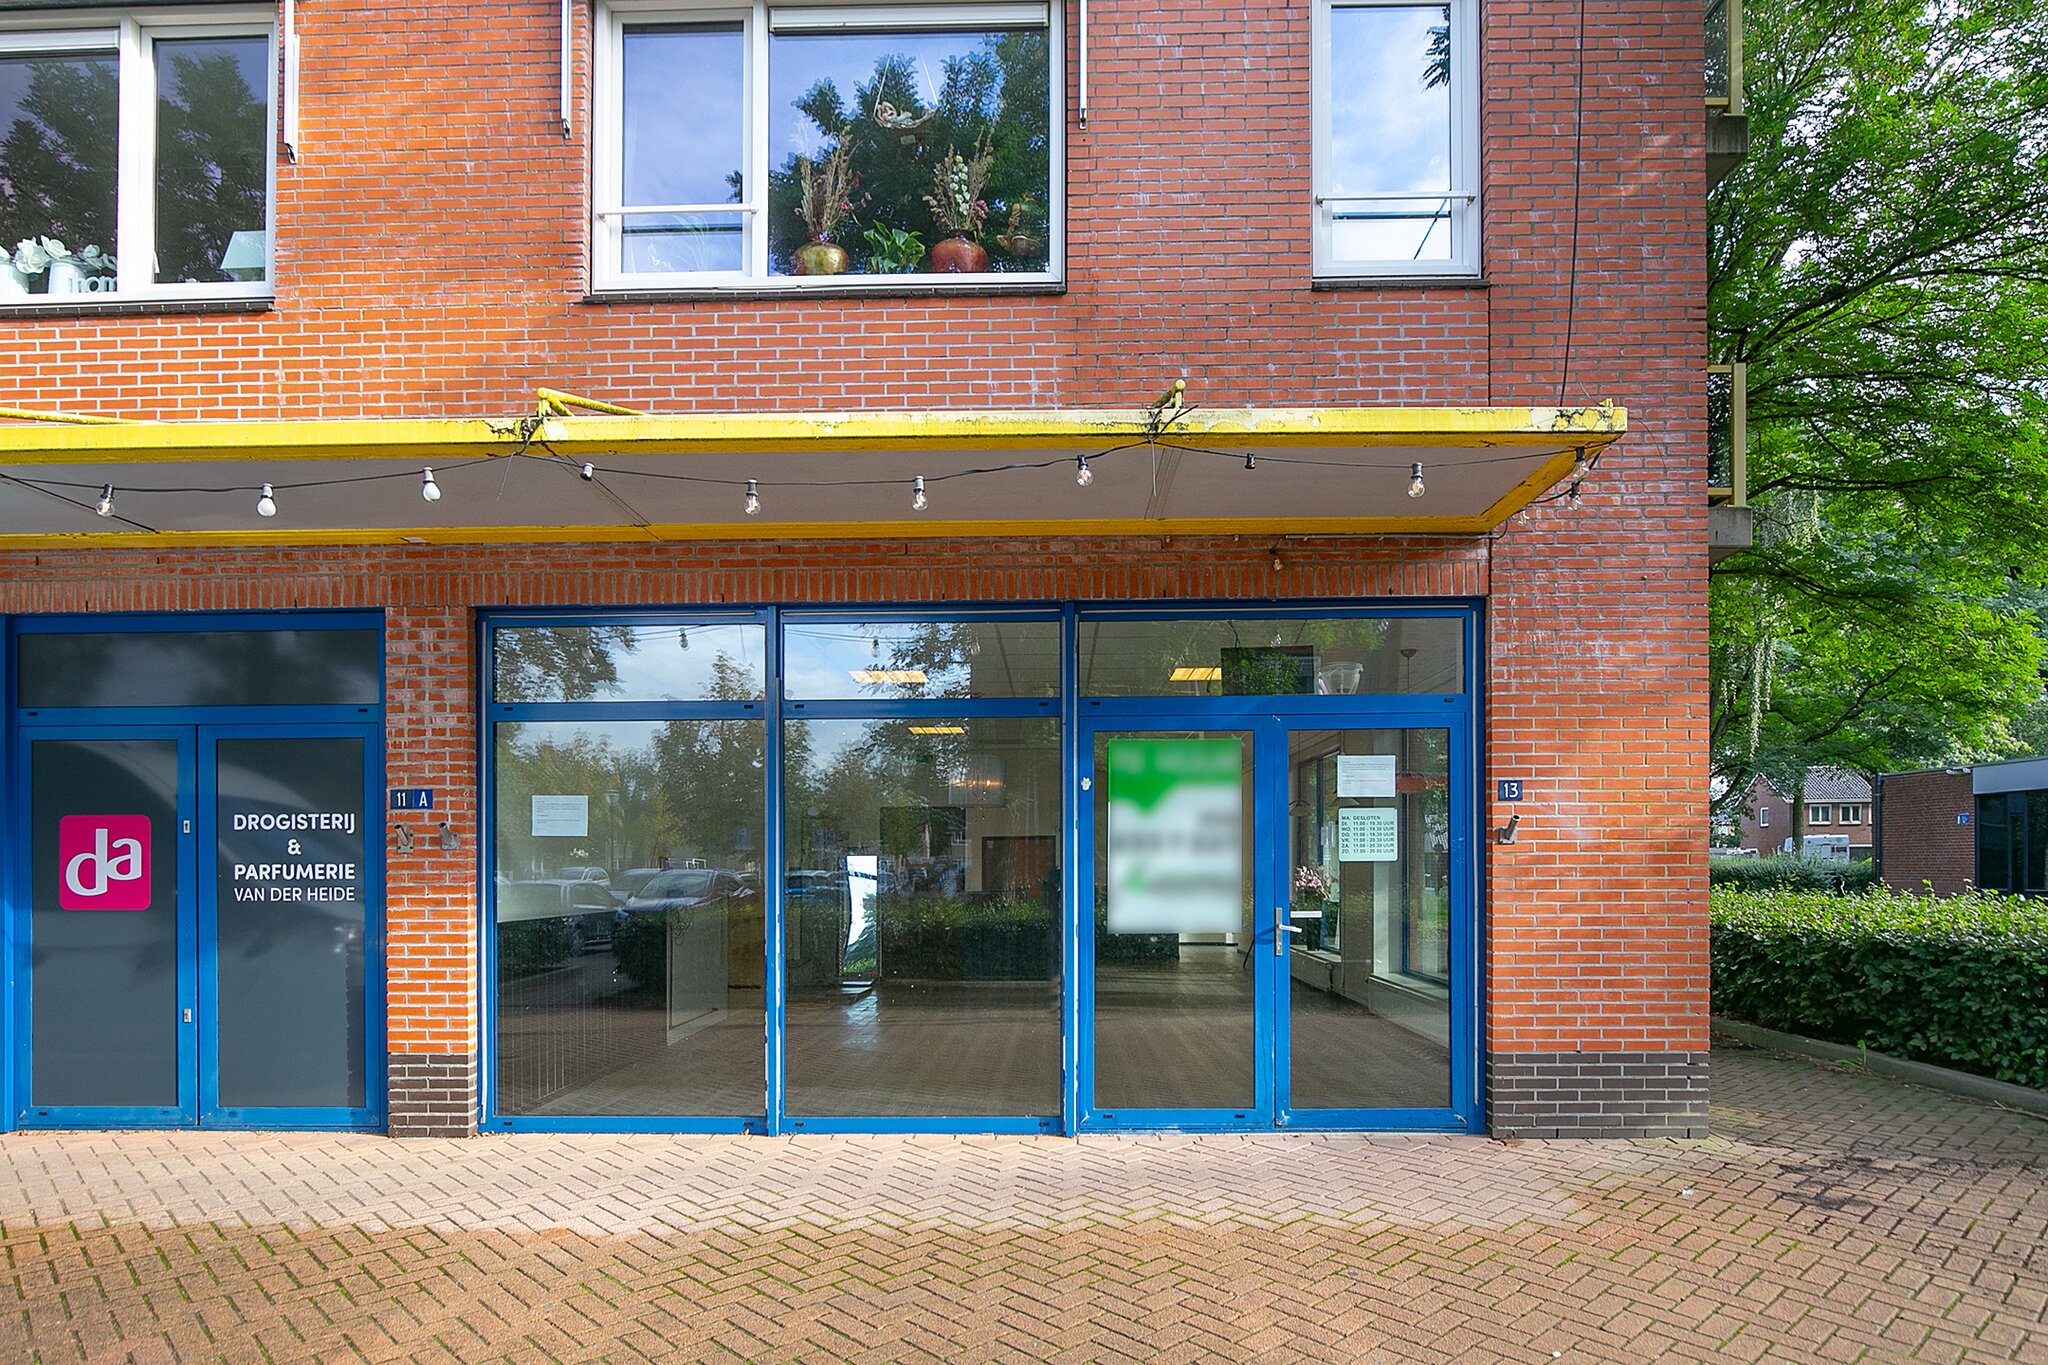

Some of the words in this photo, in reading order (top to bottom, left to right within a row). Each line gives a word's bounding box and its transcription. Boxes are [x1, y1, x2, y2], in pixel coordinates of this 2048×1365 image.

[1503, 782, 1519, 798] 13
[396, 792, 406, 807] 11
[418, 791, 428, 807] A
[233, 813, 355, 834] DROGISTERIJ
[287, 838, 302, 855] &
[65, 828, 143, 896] da
[234, 863, 355, 881] PARFUMERIE
[234, 887, 266, 902] VAN
[270, 887, 302, 902] DER
[307, 887, 355, 902] HEIDE
